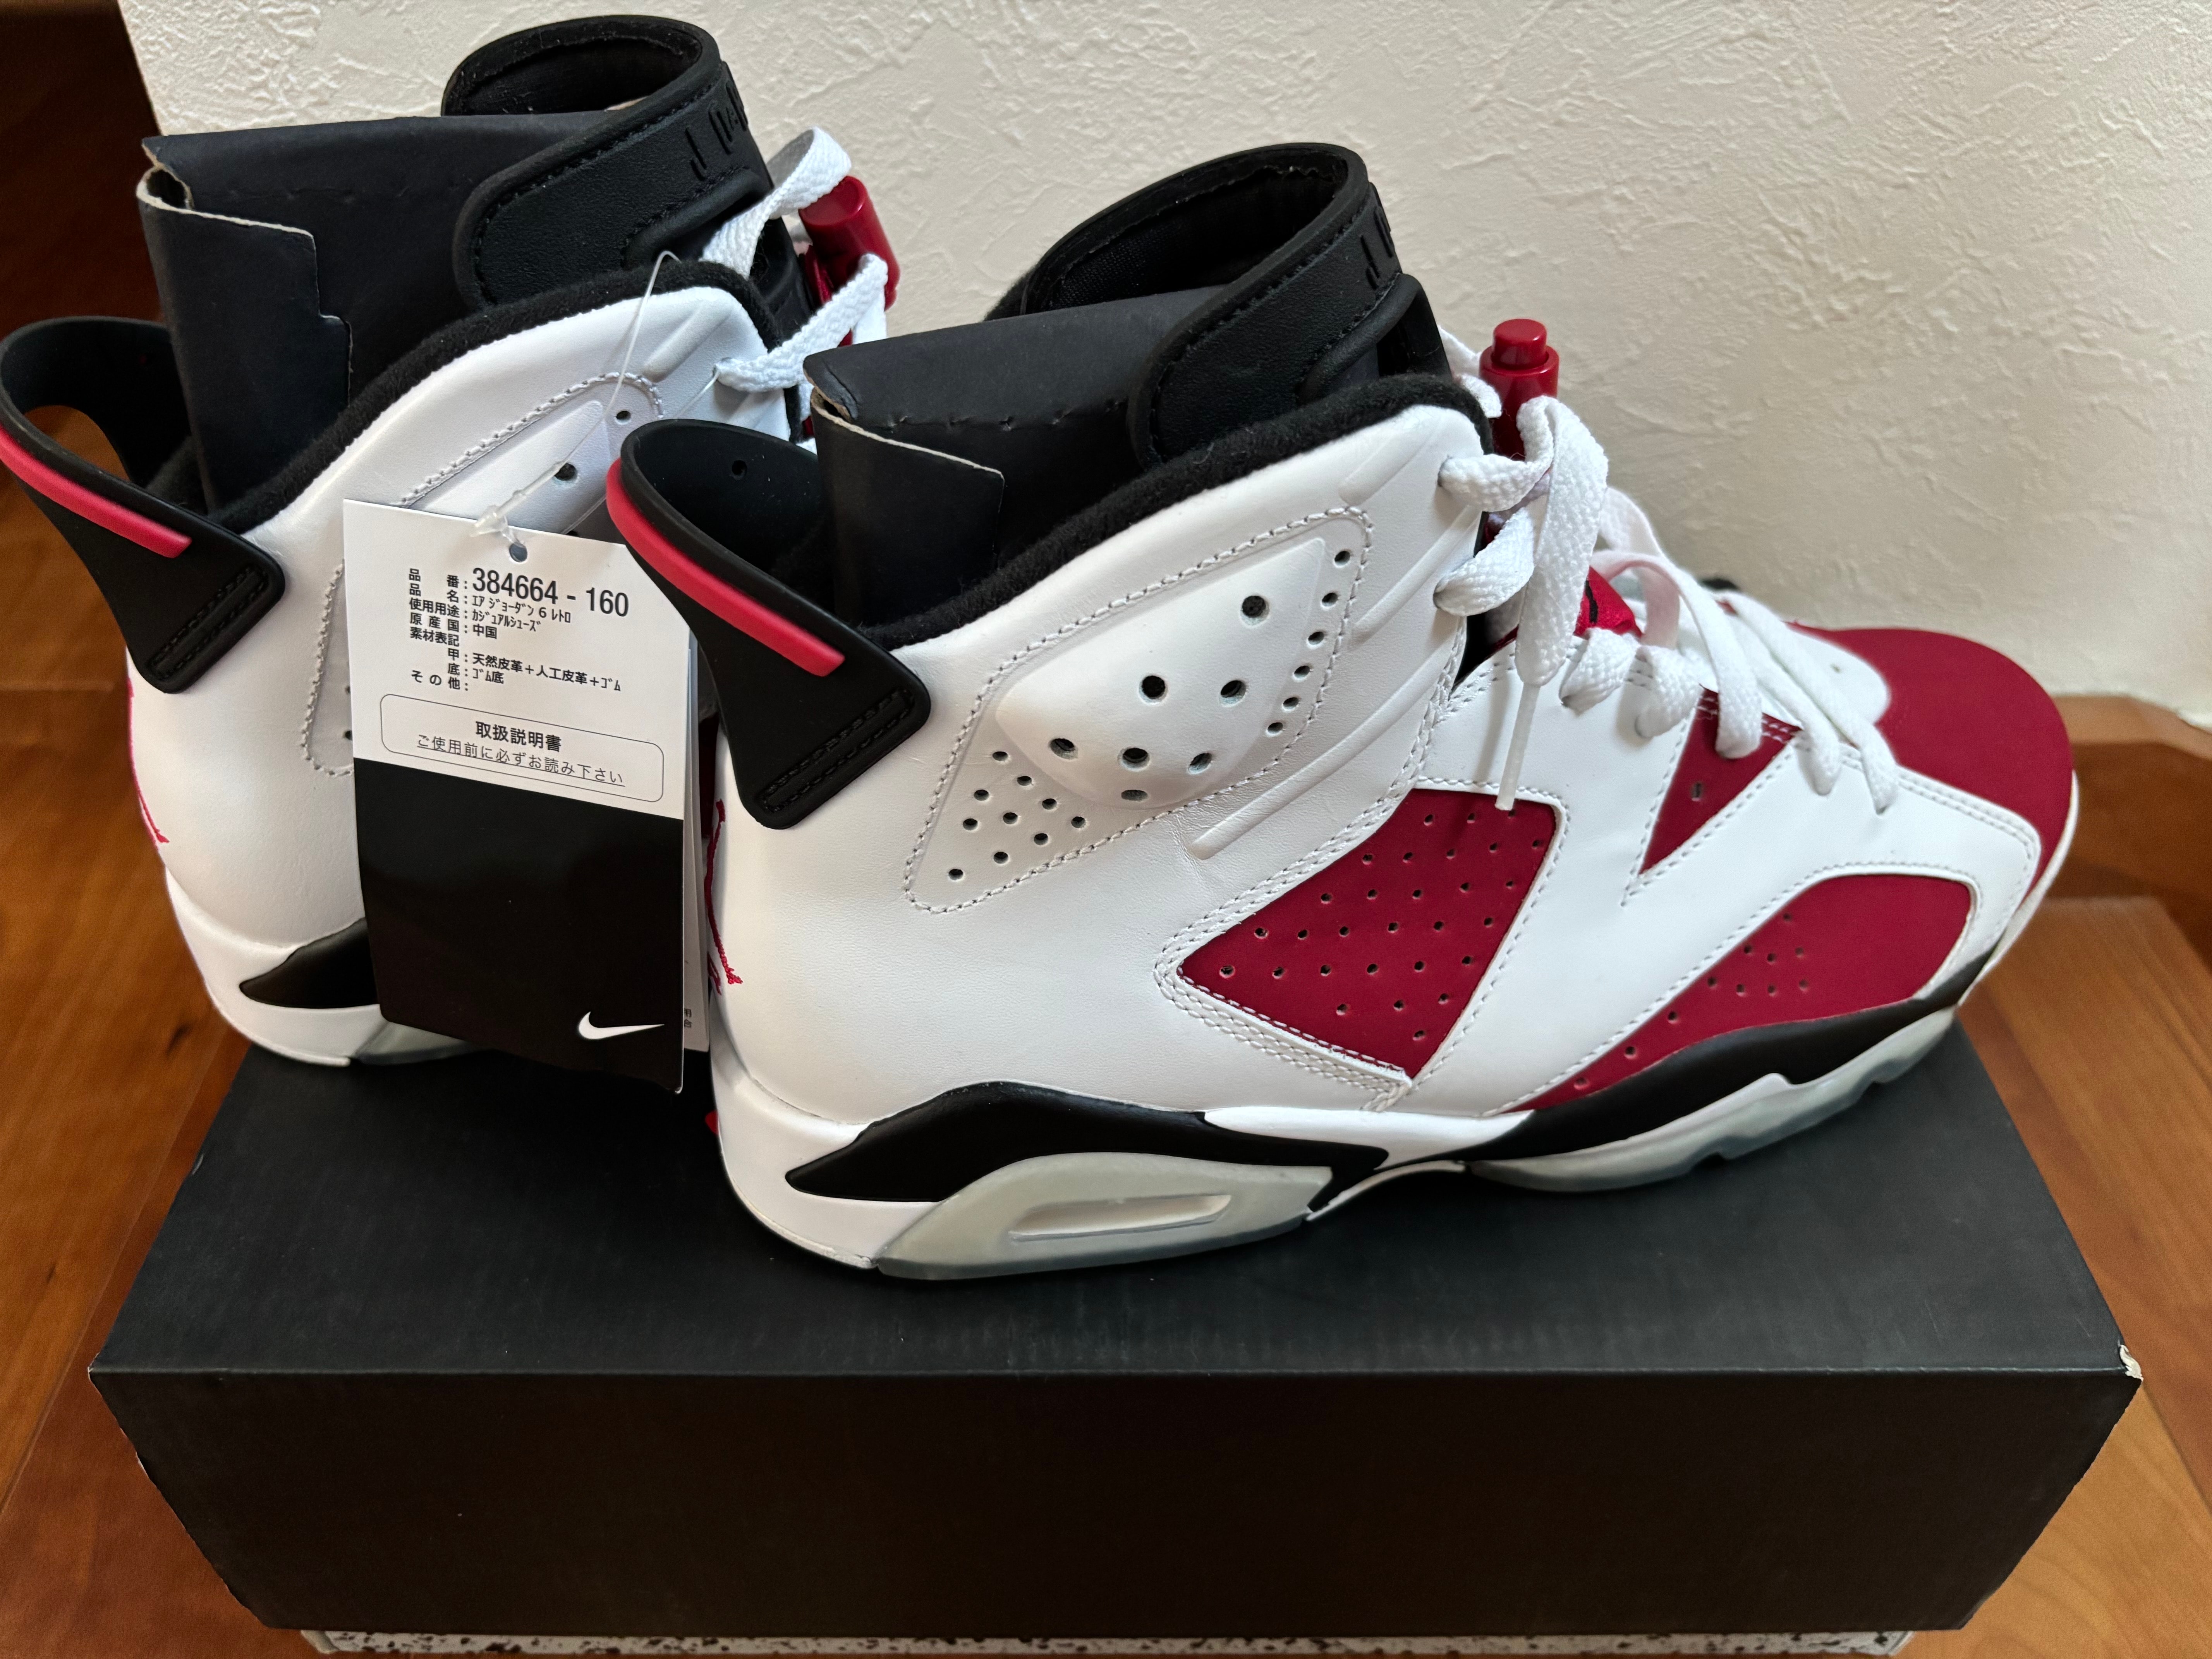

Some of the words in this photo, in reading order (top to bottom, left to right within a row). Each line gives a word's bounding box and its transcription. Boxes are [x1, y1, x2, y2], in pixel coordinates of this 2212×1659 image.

[472, 567, 558, 605] 384664
[586, 587, 629, 617] 160
[410, 627, 460, 647] 素材表記
[473, 623, 497, 639] 中国
[476, 721, 562, 752] 取扱説明書
[417, 734, 623, 783] ご使用前に必ずお読み下さい
